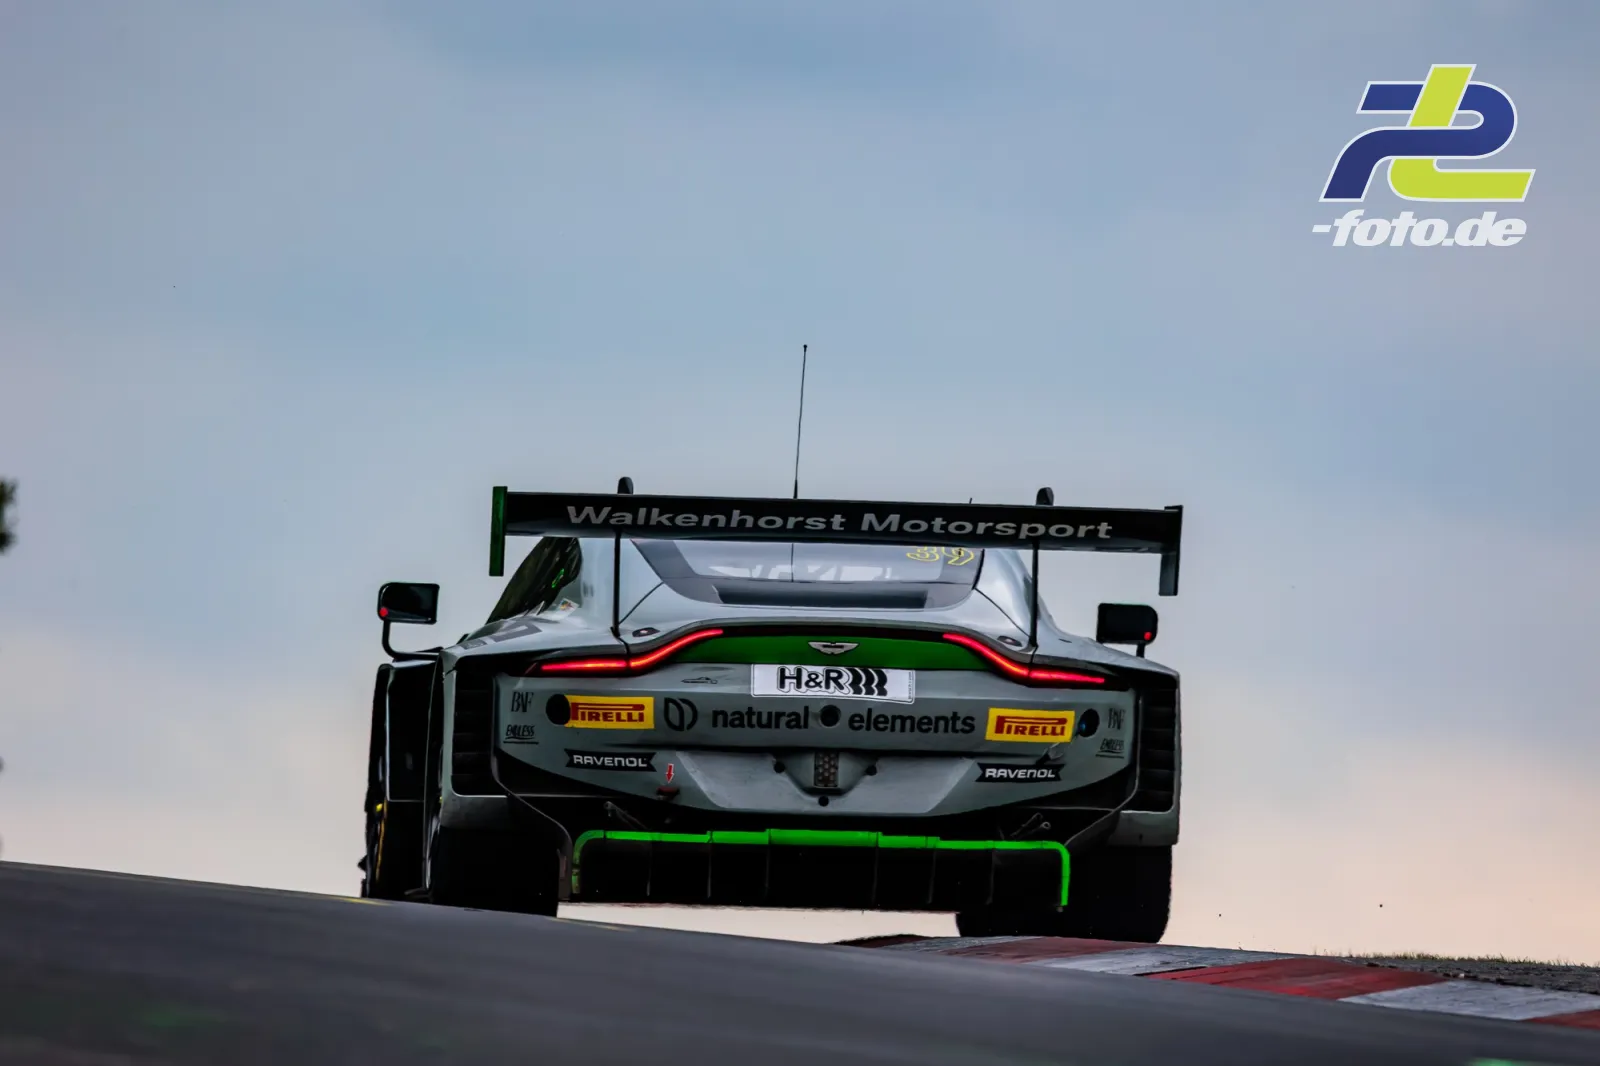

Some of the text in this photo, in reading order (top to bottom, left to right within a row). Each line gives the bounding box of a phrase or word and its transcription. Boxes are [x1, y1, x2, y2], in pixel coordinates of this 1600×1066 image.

[566, 505, 1113, 540] Walkenhorst Motorsport
[777, 666, 848, 692] H&R
[570, 702, 645, 723] PIRELLI
[712, 706, 976, 734] natural elements
[994, 715, 1068, 737] PIRELLI
[573, 754, 648, 768] RAVENOL
[985, 768, 1056, 779] RAVENOL
